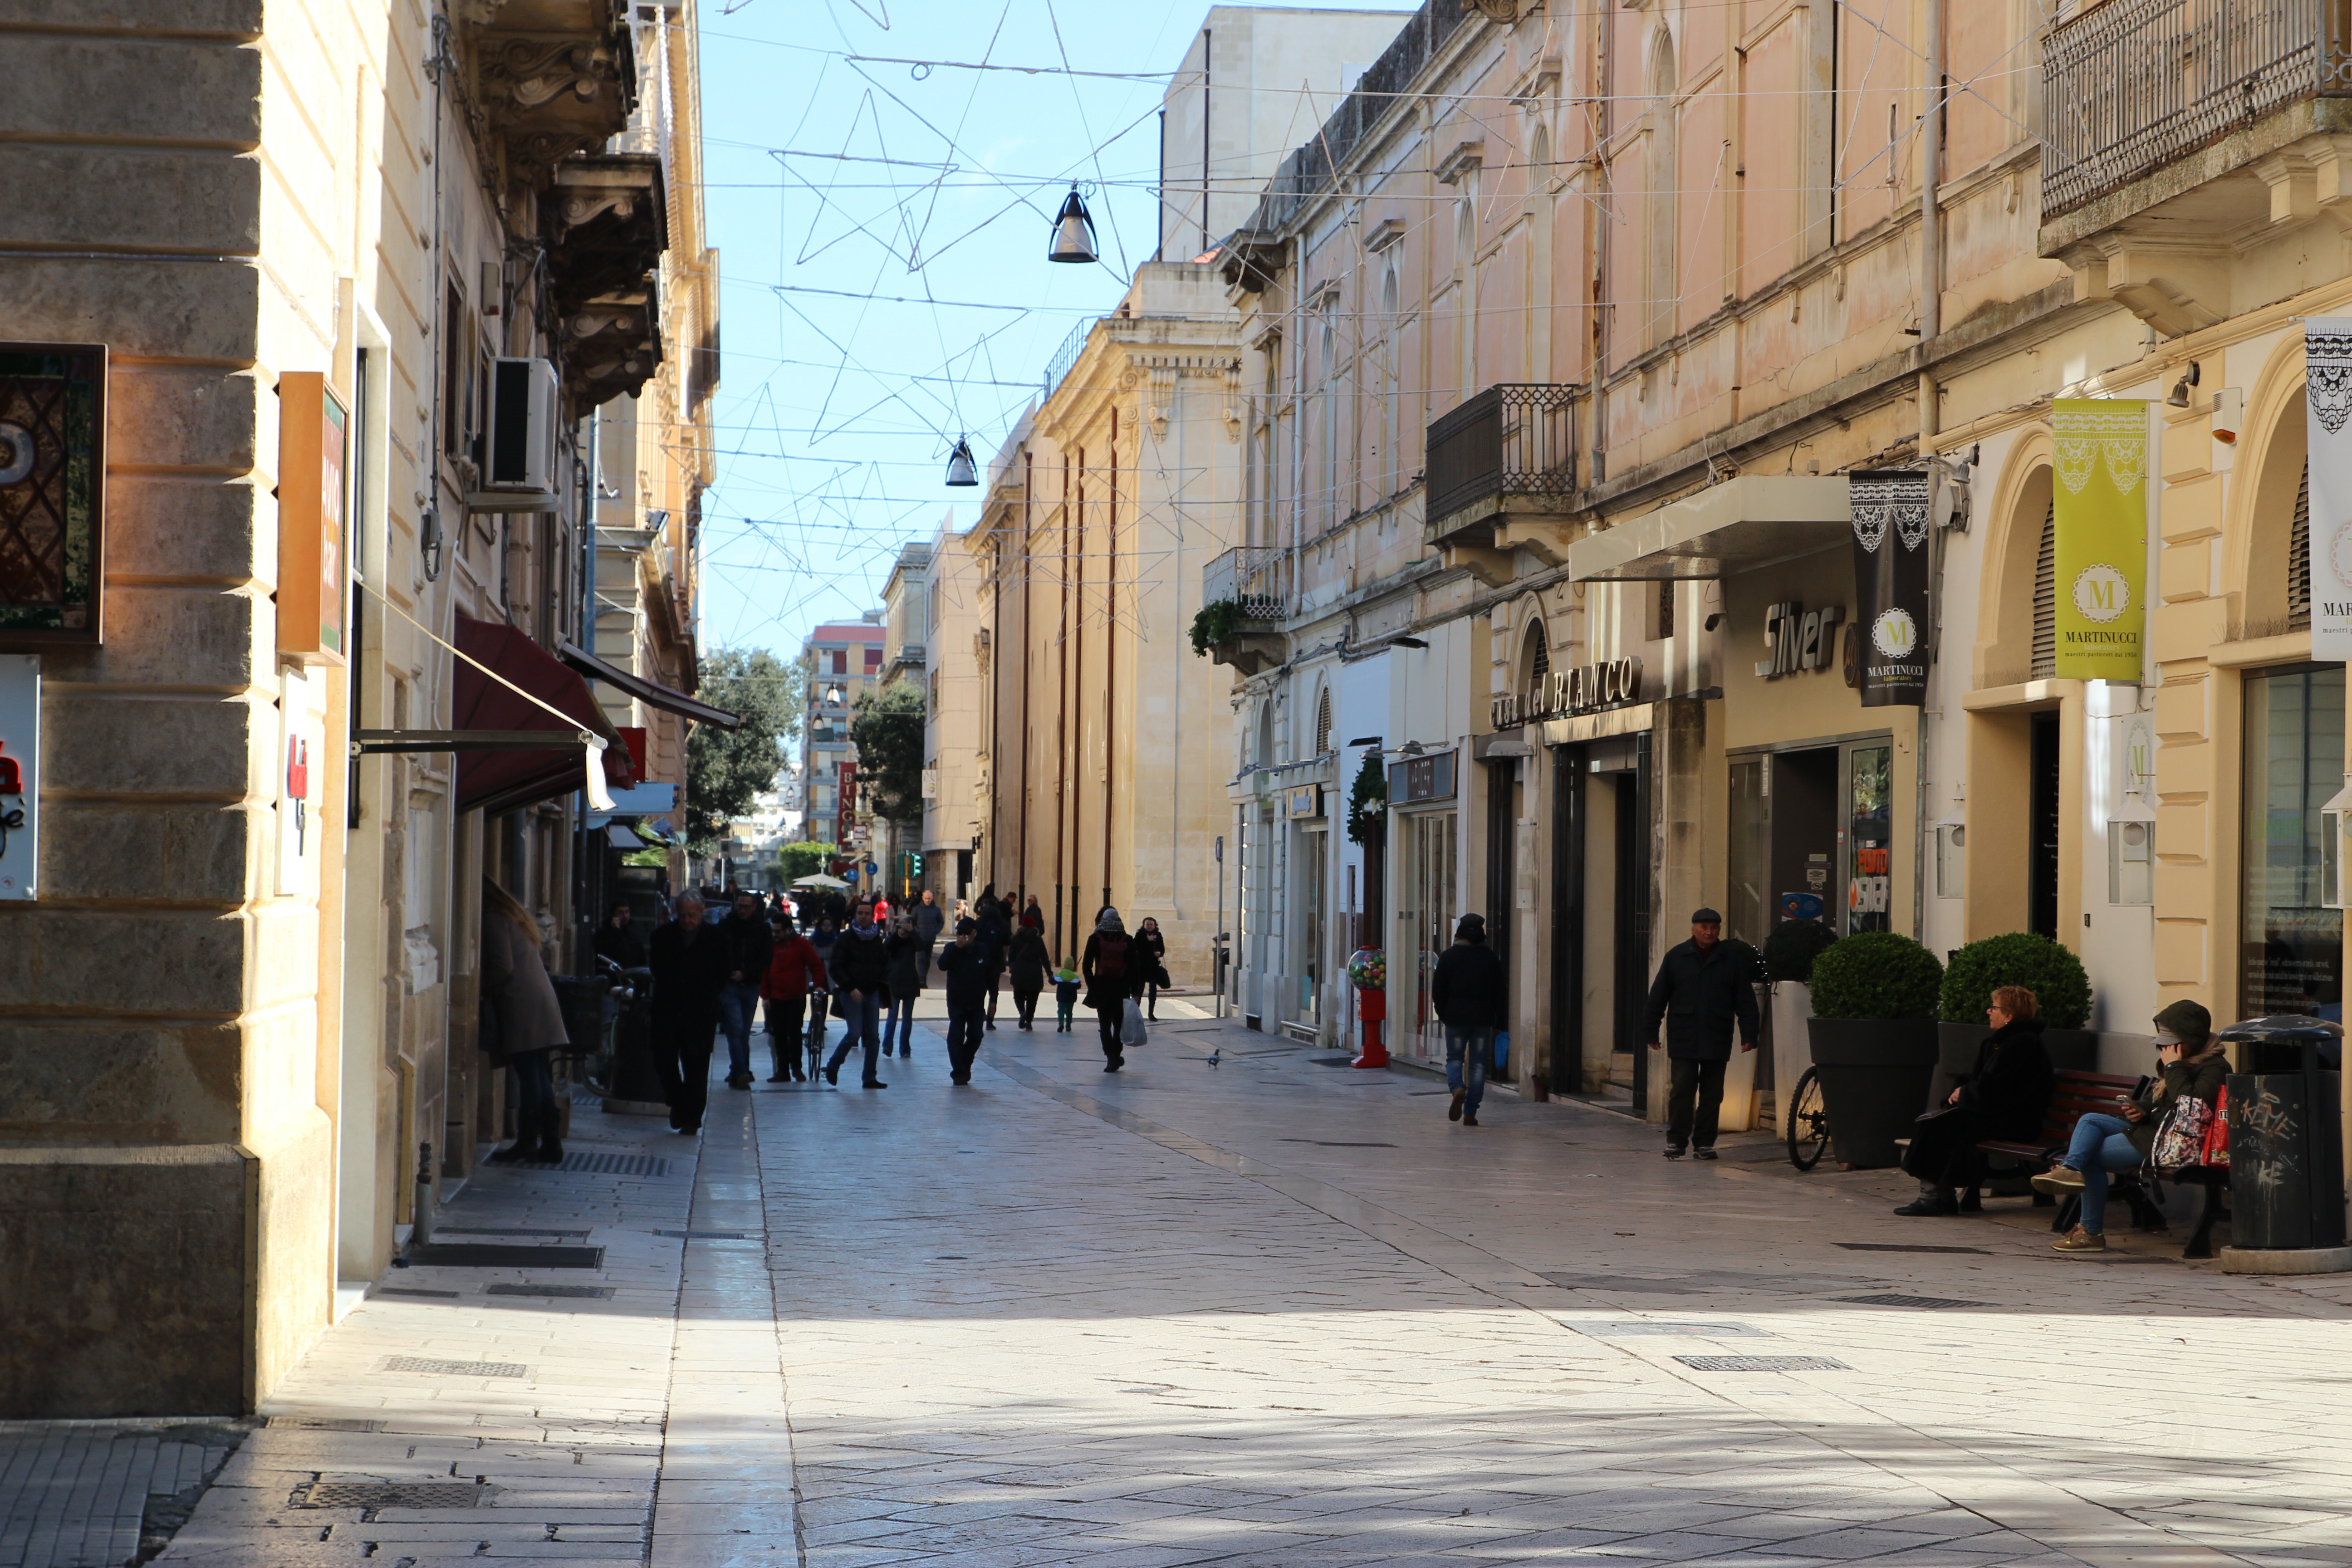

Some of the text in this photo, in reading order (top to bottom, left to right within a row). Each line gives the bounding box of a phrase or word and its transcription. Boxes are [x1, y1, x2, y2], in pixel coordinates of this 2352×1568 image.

[322, 455, 339, 526] AVIO
[323, 524, 337, 589] bar
[2086, 580, 2117, 609] M
[1755, 602, 1840, 677] Silver
[1884, 621, 1909, 646] M
[2065, 632, 2137, 644] MARTINUCCI
[2084, 643, 2120, 652] laboratory
[1490, 695, 1518, 726] casa
[1552, 656, 1637, 713] BIANCO
[1867, 665, 1923, 677] MARTINUCCI
[841, 772, 853, 834] BING
